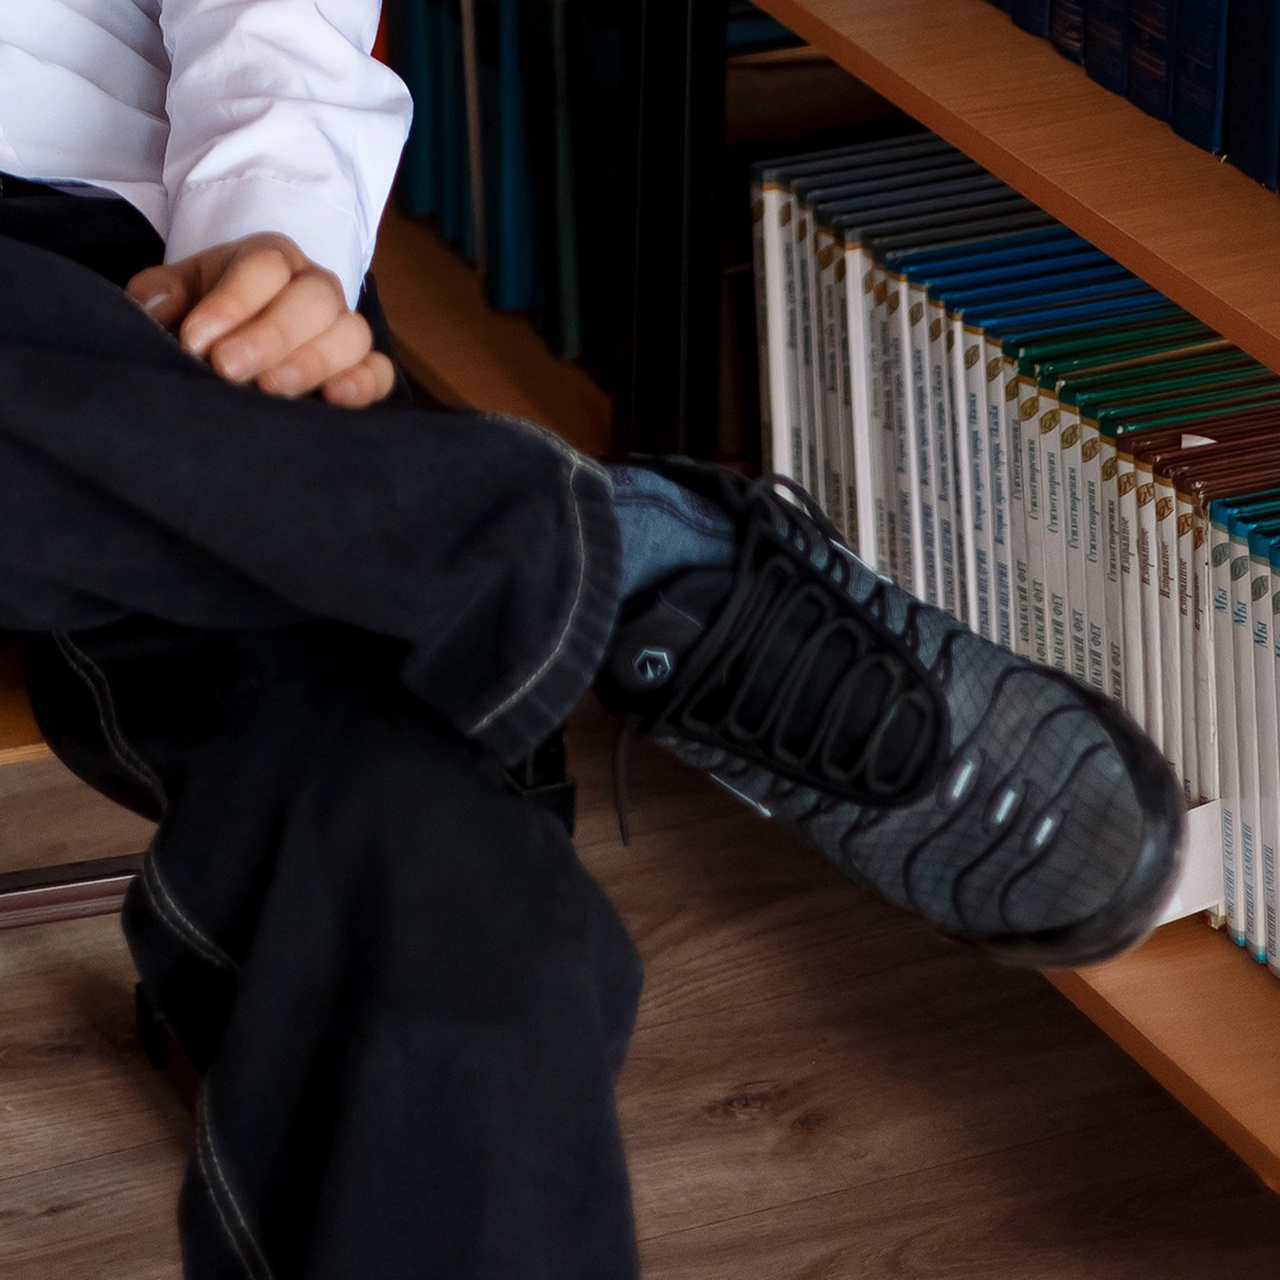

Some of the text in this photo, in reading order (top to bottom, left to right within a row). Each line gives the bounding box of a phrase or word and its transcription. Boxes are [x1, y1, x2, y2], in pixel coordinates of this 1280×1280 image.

[1214, 587, 1228, 614] Мы
[1233, 601, 1248, 628] Мы
[1053, 620, 1065, 671] ФАНАСИЙ
[1253, 620, 1268, 649] Мы
[1090, 651, 1103, 692] АНАСИЙ
